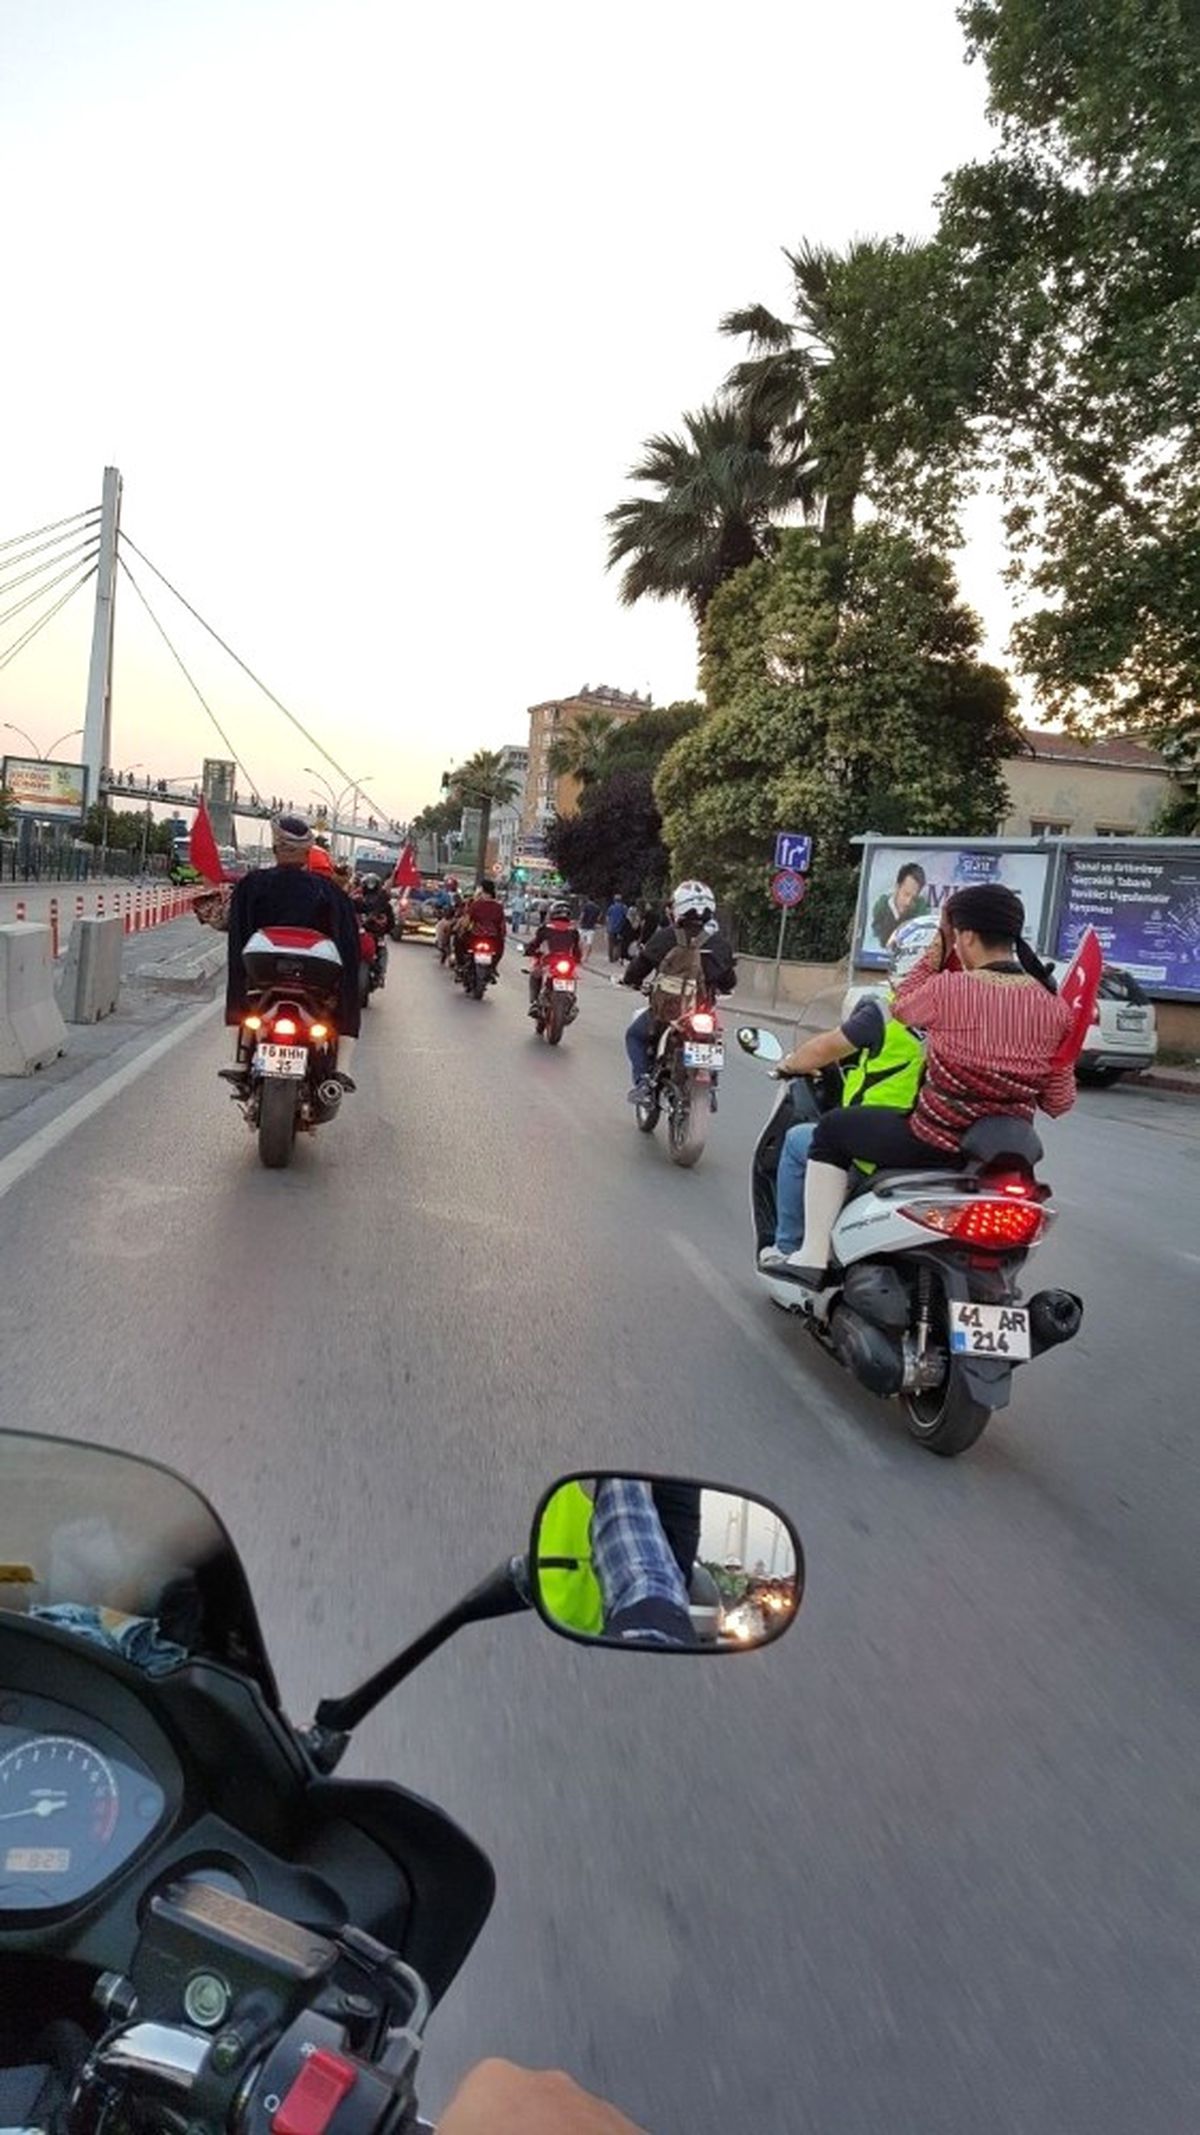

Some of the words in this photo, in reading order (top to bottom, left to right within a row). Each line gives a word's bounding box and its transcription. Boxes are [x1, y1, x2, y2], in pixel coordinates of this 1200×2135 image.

[262, 1045, 276, 1058] 16
[958, 1306, 982, 1328] 41
[998, 1310, 1026, 1333] AR
[972, 1330, 1010, 1353] 214
